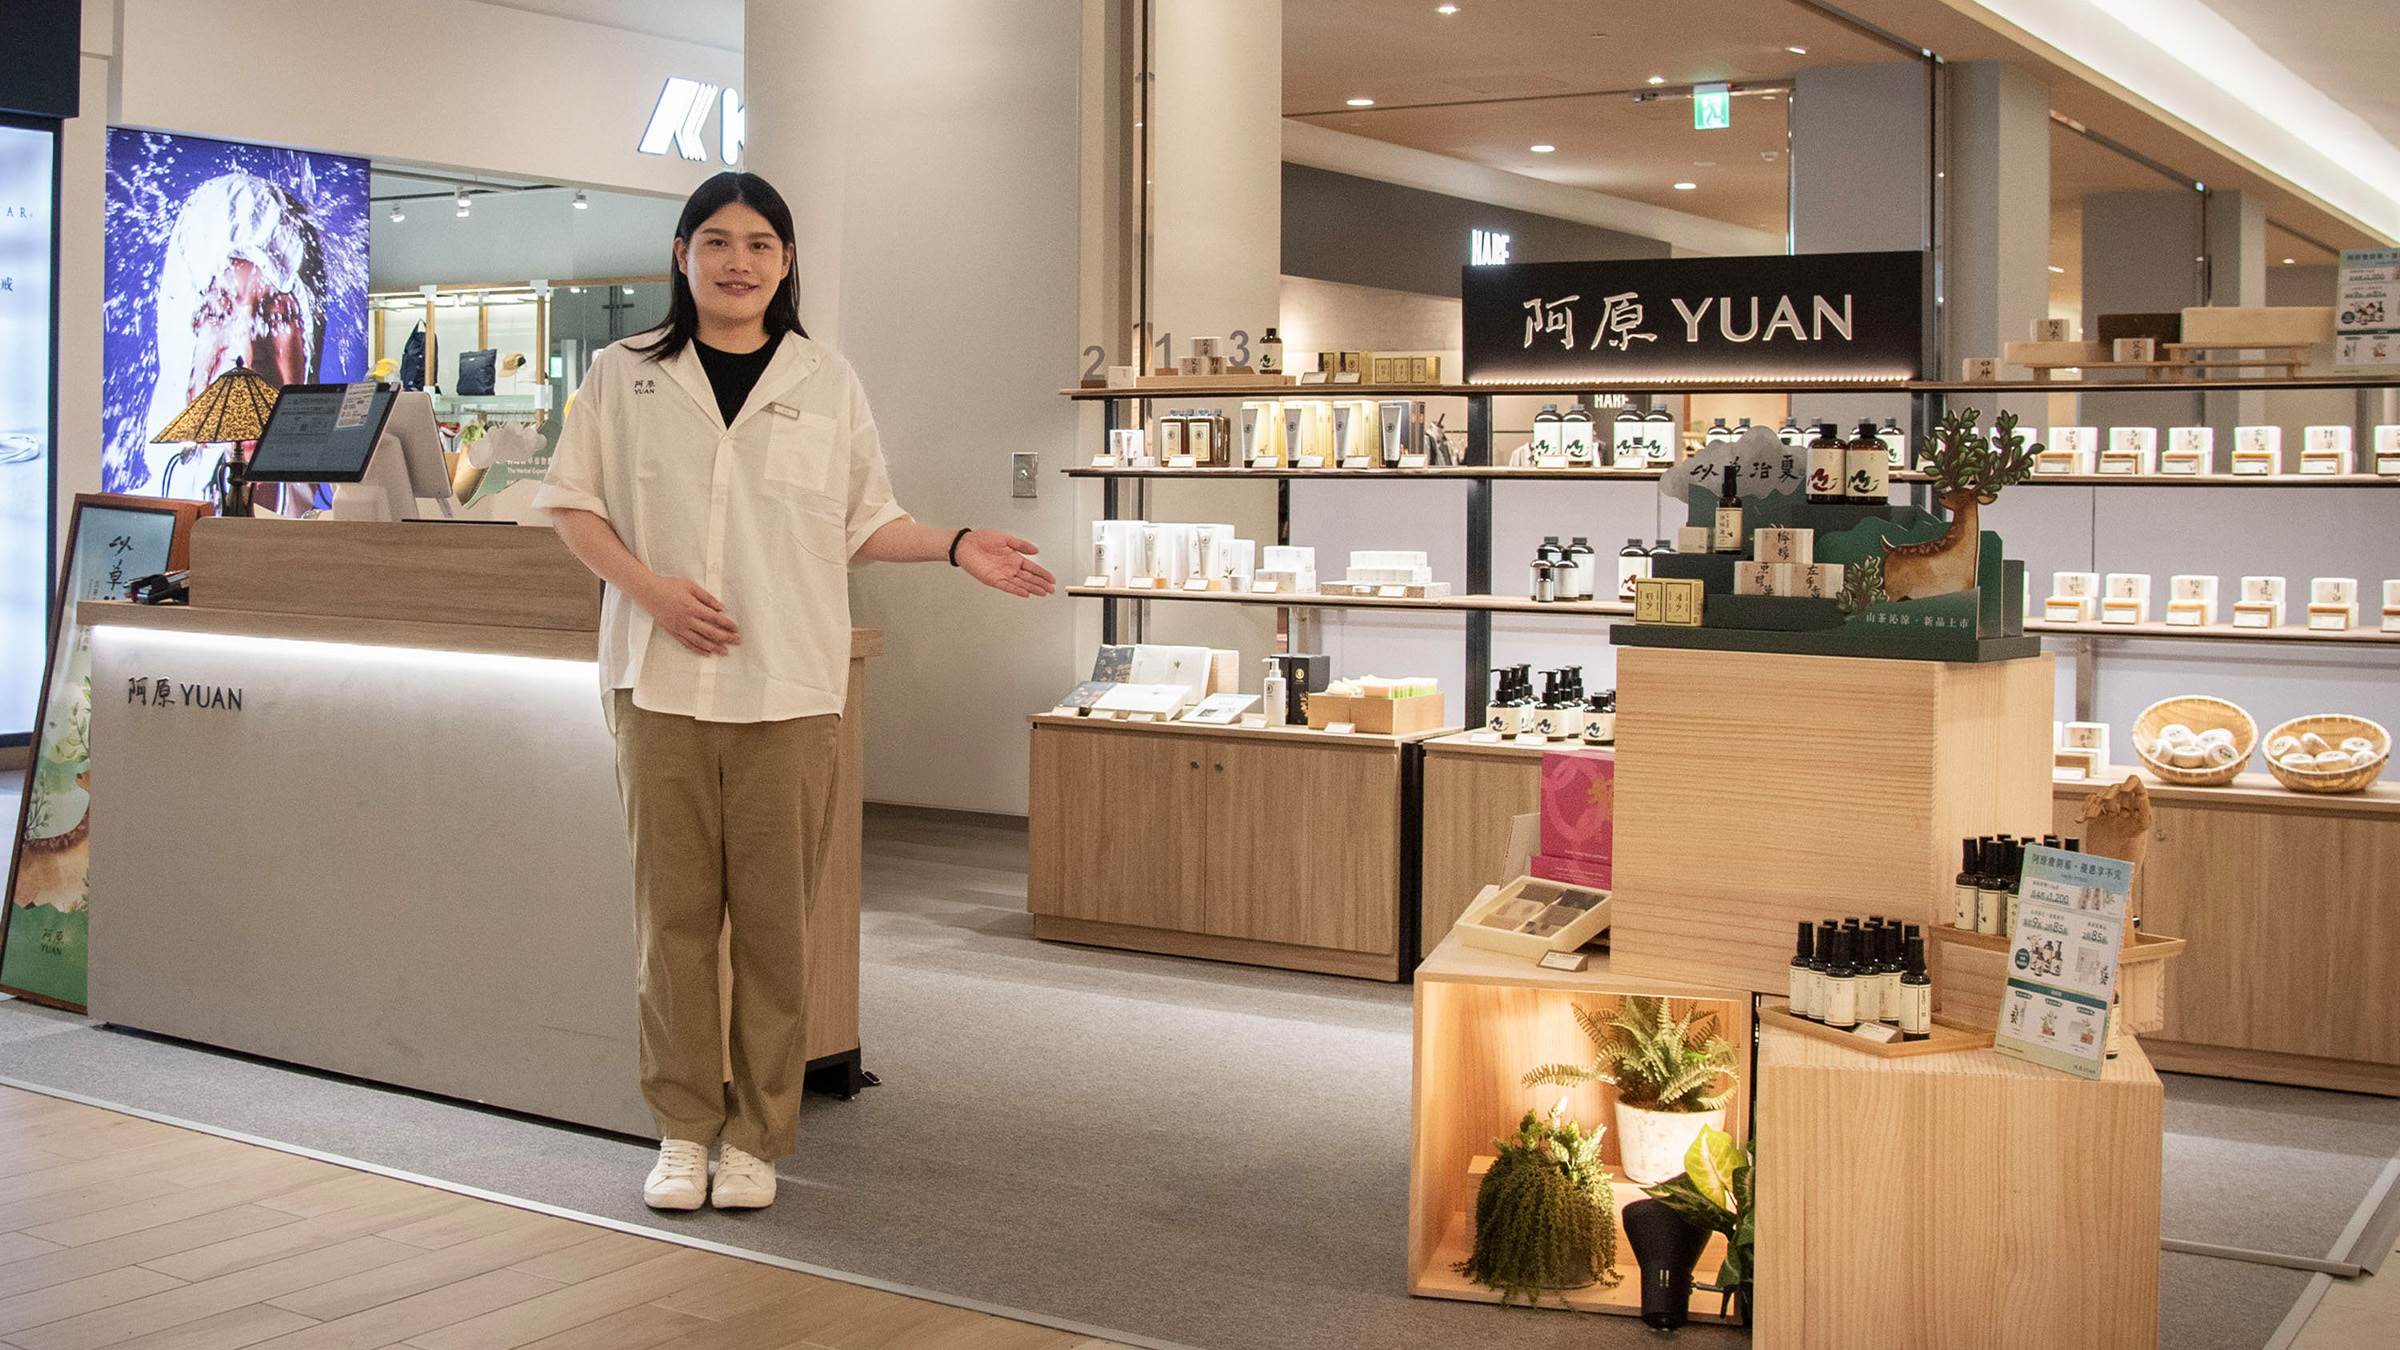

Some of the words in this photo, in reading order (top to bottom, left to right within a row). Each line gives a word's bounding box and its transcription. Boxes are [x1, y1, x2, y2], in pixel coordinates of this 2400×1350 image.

[1522, 291, 1658, 351] 阿原
[1671, 294, 1852, 343] YUAN
[1083, 345, 1105, 381] 2
[1155, 333, 1171, 368] 1
[1229, 330, 1250, 367] 3
[128, 676, 175, 708] 阿原
[180, 683, 242, 711] YUAN
